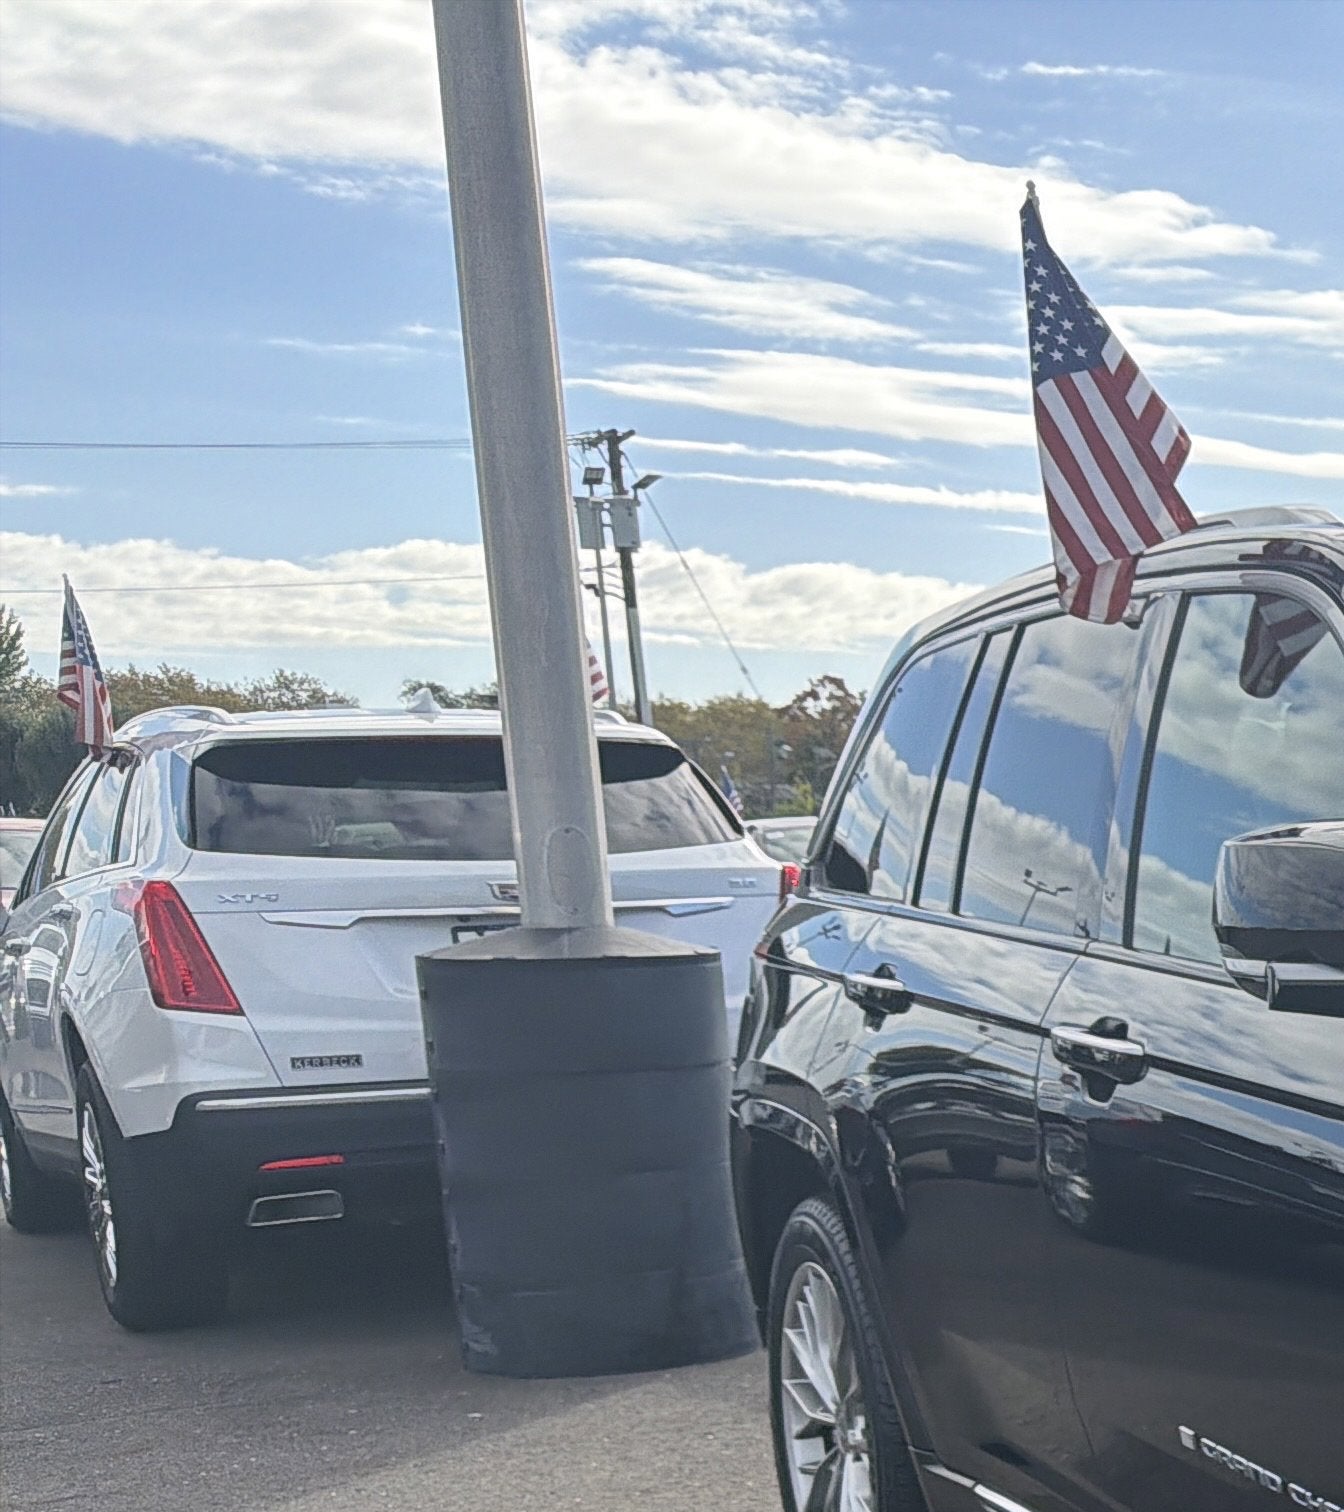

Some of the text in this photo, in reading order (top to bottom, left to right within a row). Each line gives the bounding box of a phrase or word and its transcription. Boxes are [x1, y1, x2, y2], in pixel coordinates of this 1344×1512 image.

[217, 893, 280, 904] XT5
[293, 1056, 359, 1070] KERBECK
[1200, 1437, 1283, 1494] GRAND
